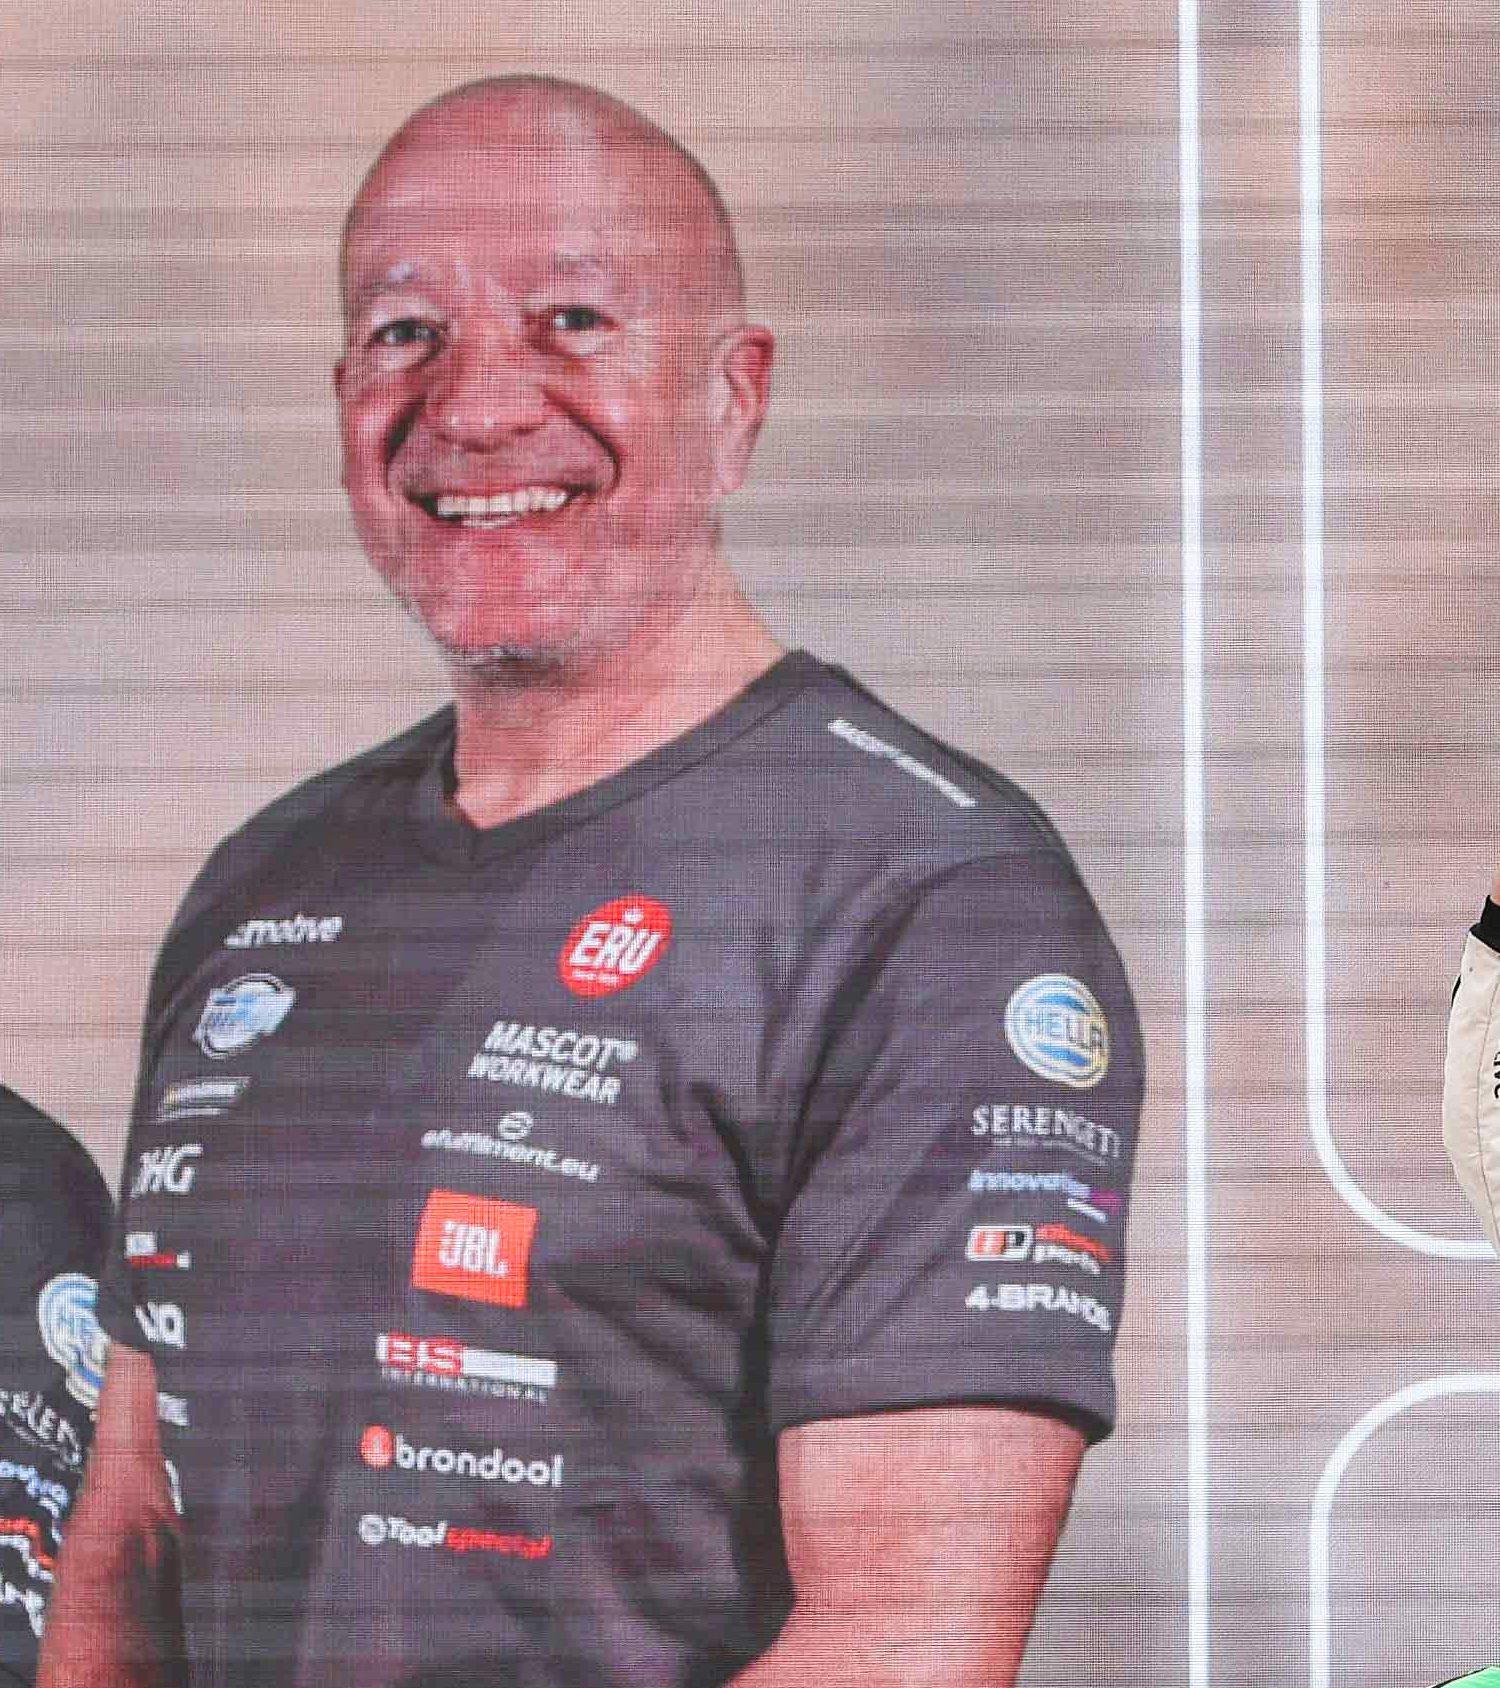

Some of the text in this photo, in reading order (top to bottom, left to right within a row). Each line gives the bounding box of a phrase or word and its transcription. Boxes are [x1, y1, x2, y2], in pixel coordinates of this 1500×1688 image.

[569, 921, 663, 975] ERU
[467, 1053, 621, 1104] WORKWEAR
[437, 1220, 510, 1280] JBL
[394, 1434, 565, 1488] brondool
